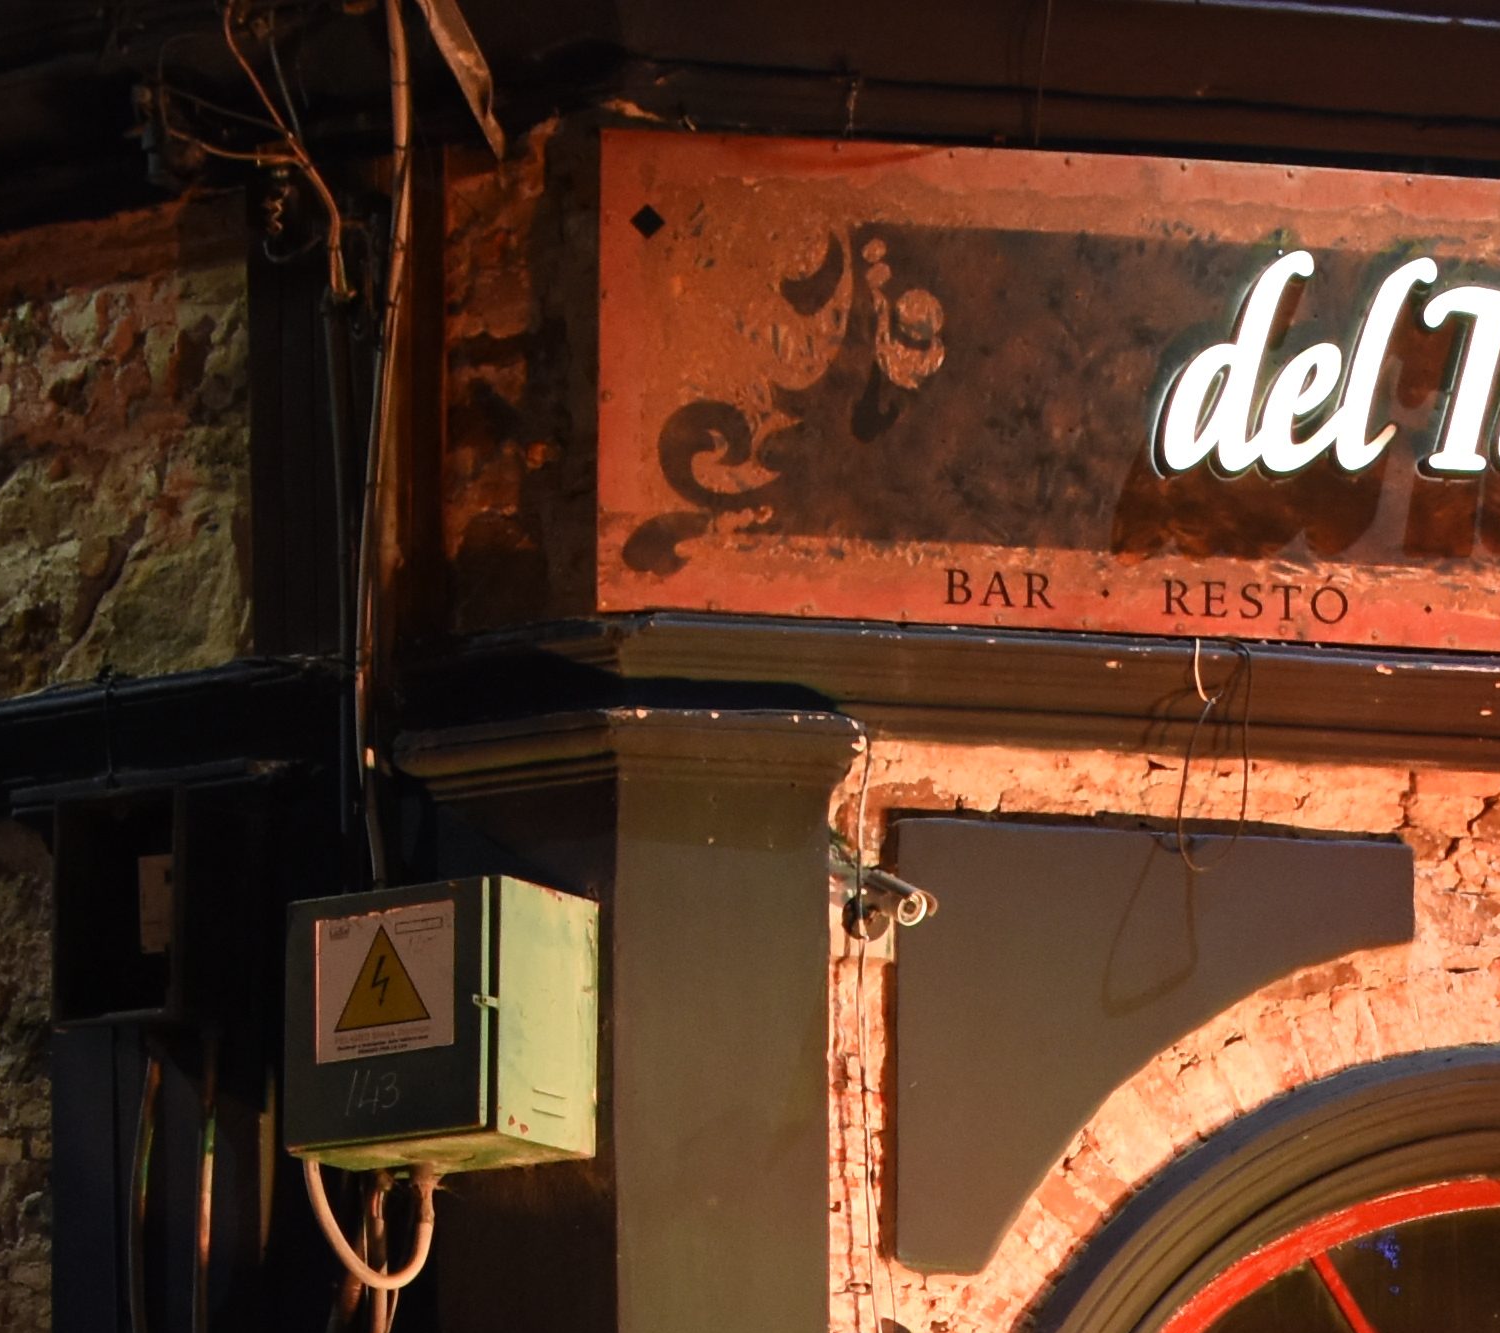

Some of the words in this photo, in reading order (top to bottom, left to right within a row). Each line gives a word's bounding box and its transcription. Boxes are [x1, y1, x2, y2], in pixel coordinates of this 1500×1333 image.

[1153, 251, 1438, 479] del
[945, 568, 1055, 609] BAR
[1161, 575, 1349, 625] RESTÓ
